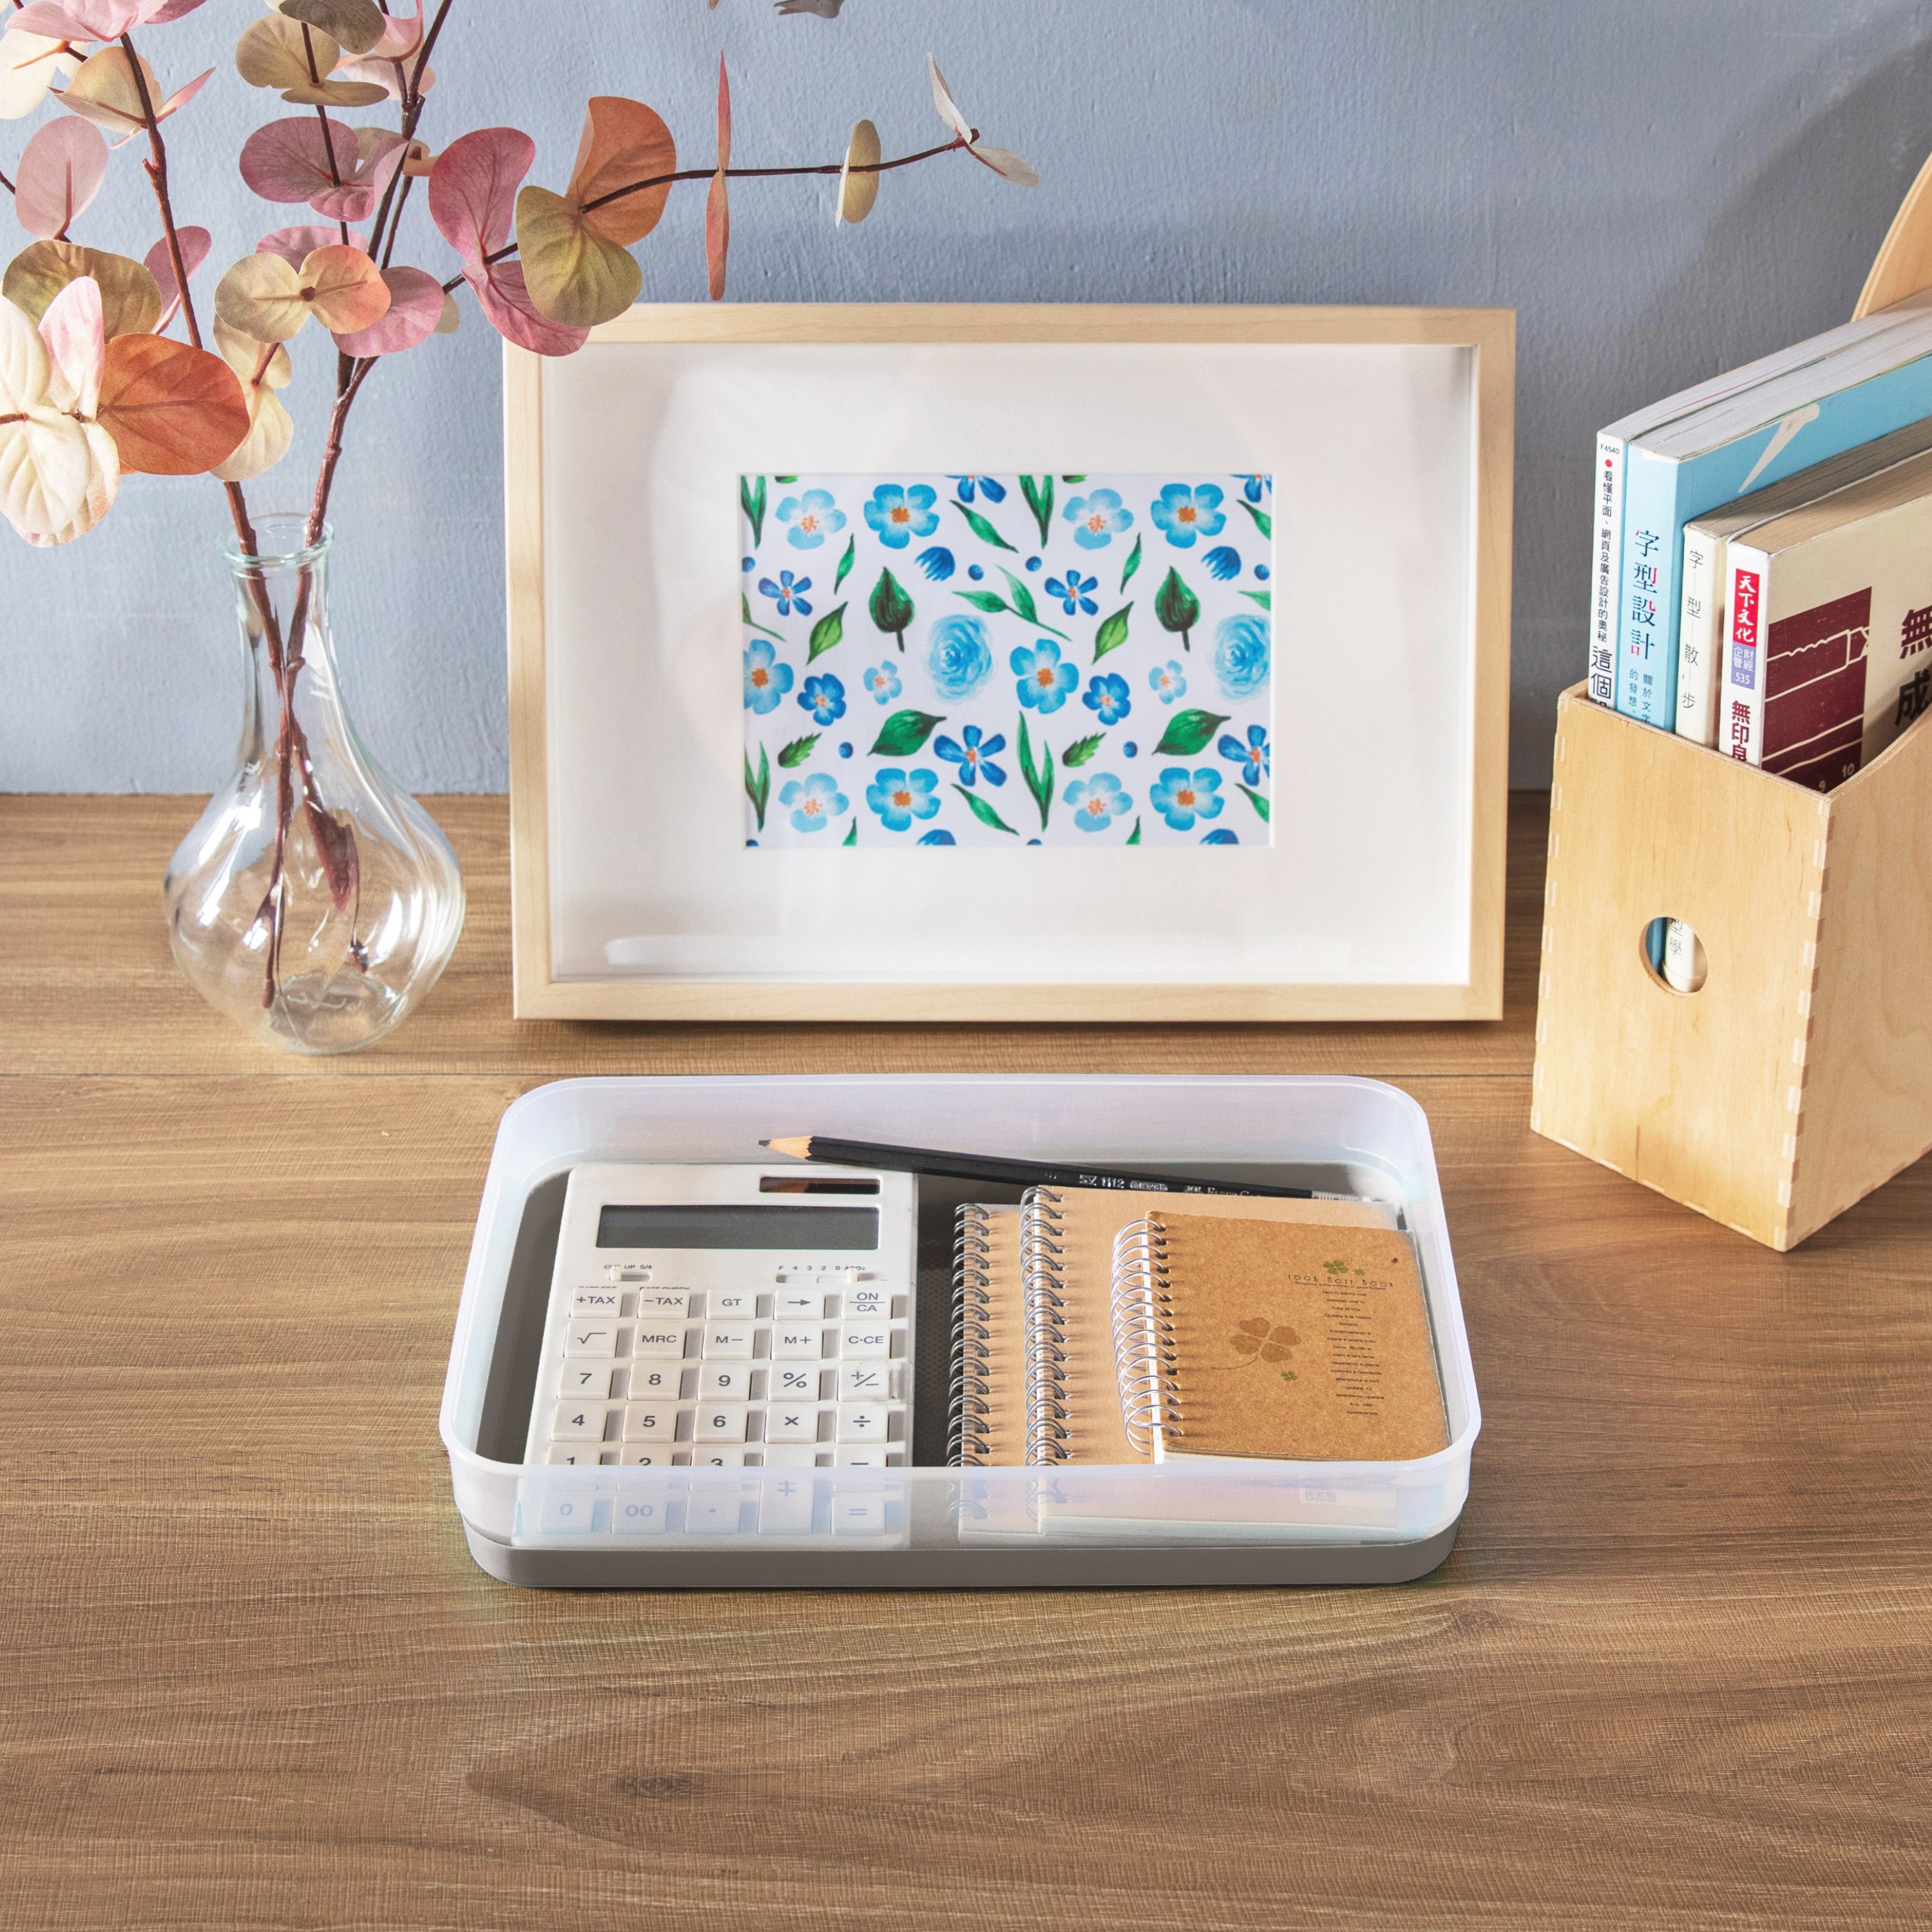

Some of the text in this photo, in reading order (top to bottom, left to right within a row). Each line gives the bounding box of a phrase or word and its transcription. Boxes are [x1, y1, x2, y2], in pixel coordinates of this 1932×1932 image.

[1600, 444, 1620, 455] F4540
[1631, 529, 1660, 660] 字型設計
[1735, 574, 1756, 643] 天下文化
[1682, 550, 1703, 708] 字型散步
[1589, 645, 1612, 707] 這個
[1736, 672, 1750, 685] 535
[576, 1296, 616, 1304] +TAX
[721, 1298, 743, 1307] GT
[857, 1292, 878, 1301] ON
[641, 1334, 677, 1343] MRC
[580, 1372, 592, 1385] 7
[649, 1374, 661, 1386] 8
[718, 1374, 731, 1387] 9
[571, 1414, 585, 1426] 4
[643, 1415, 656, 1428] 5
[713, 1415, 726, 1428] 6
